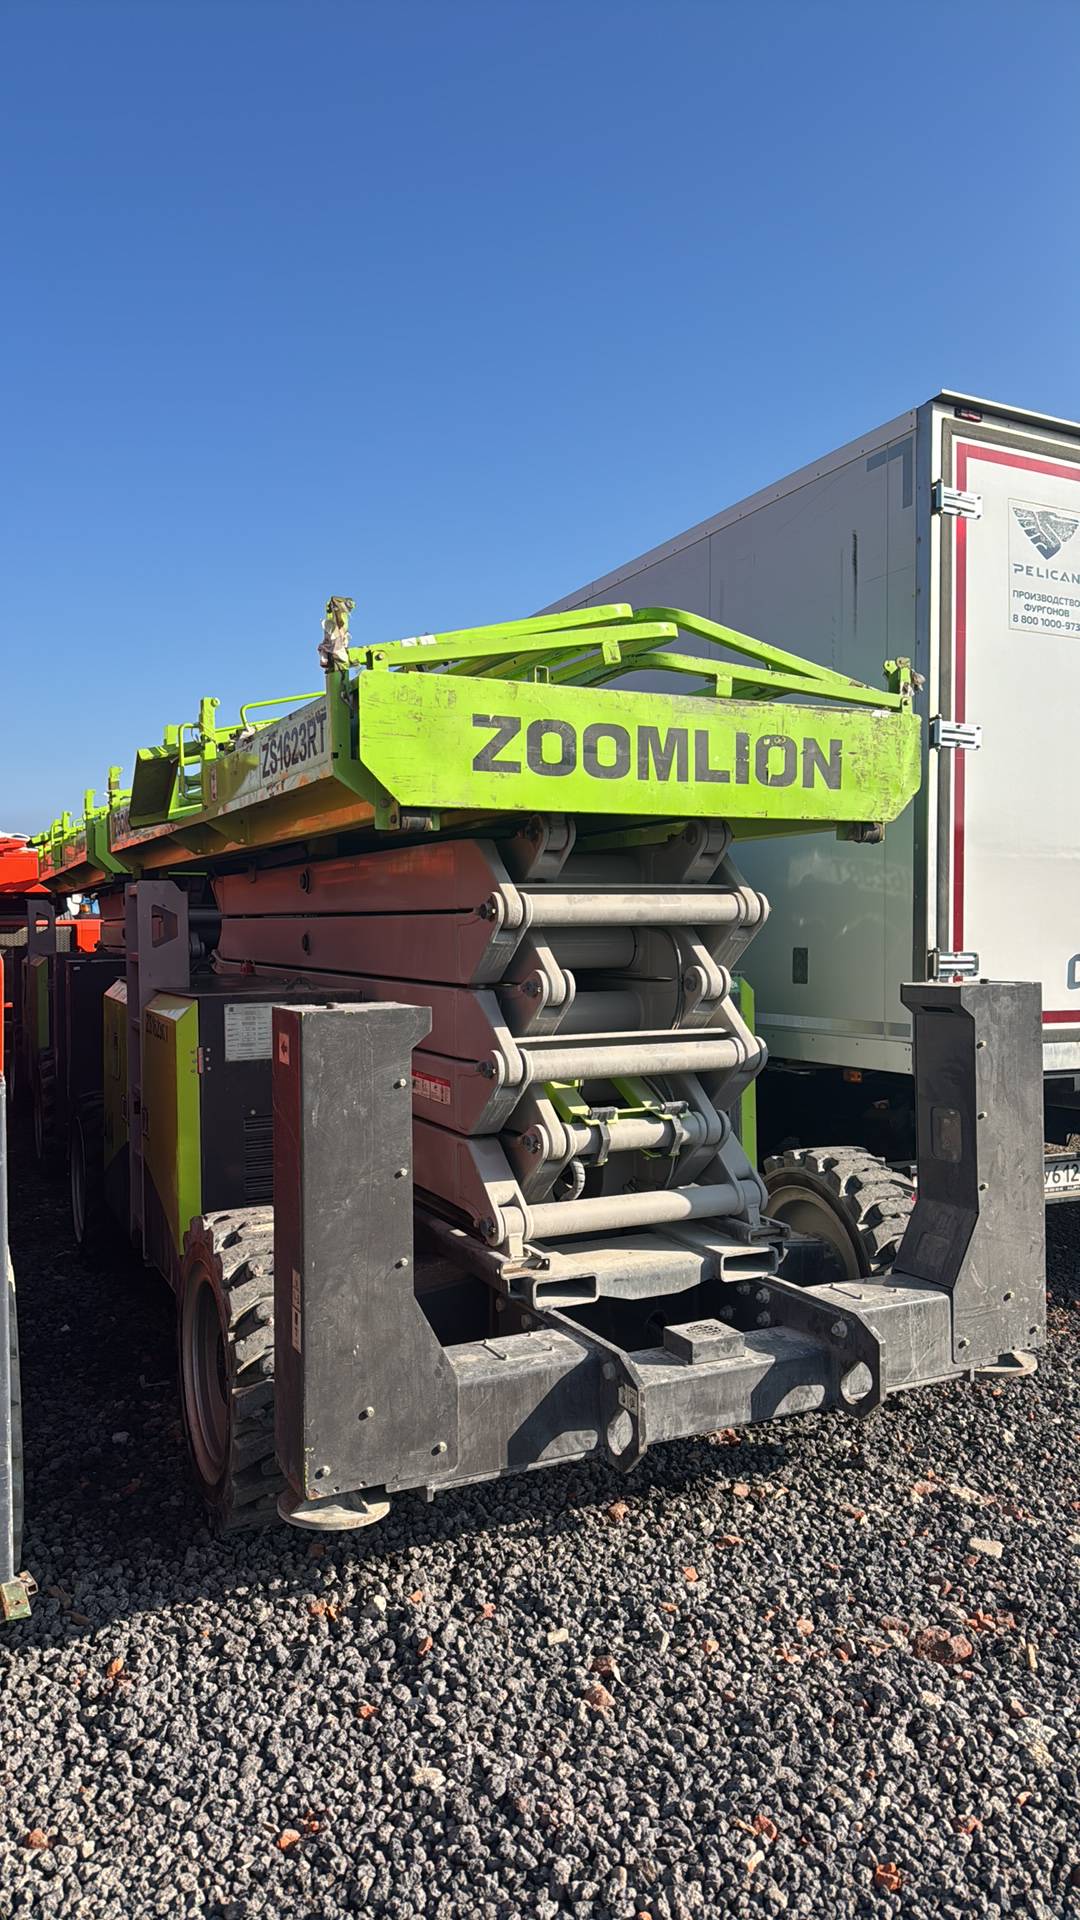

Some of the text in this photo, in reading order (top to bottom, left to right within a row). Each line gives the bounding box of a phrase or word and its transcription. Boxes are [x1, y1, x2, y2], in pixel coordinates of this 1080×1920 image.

[1013, 564, 1080, 584] PELICAN
[1013, 590, 1080, 607] ПРОИЗВОДСТВО
[1012, 614, 1019, 623] 8
[1021, 615, 1039, 625] 800
[1024, 604, 1069, 617] ФУРГОНОВ
[262, 711, 327, 778] ZS1623RT
[472, 713, 842, 790] ZOOMLION
